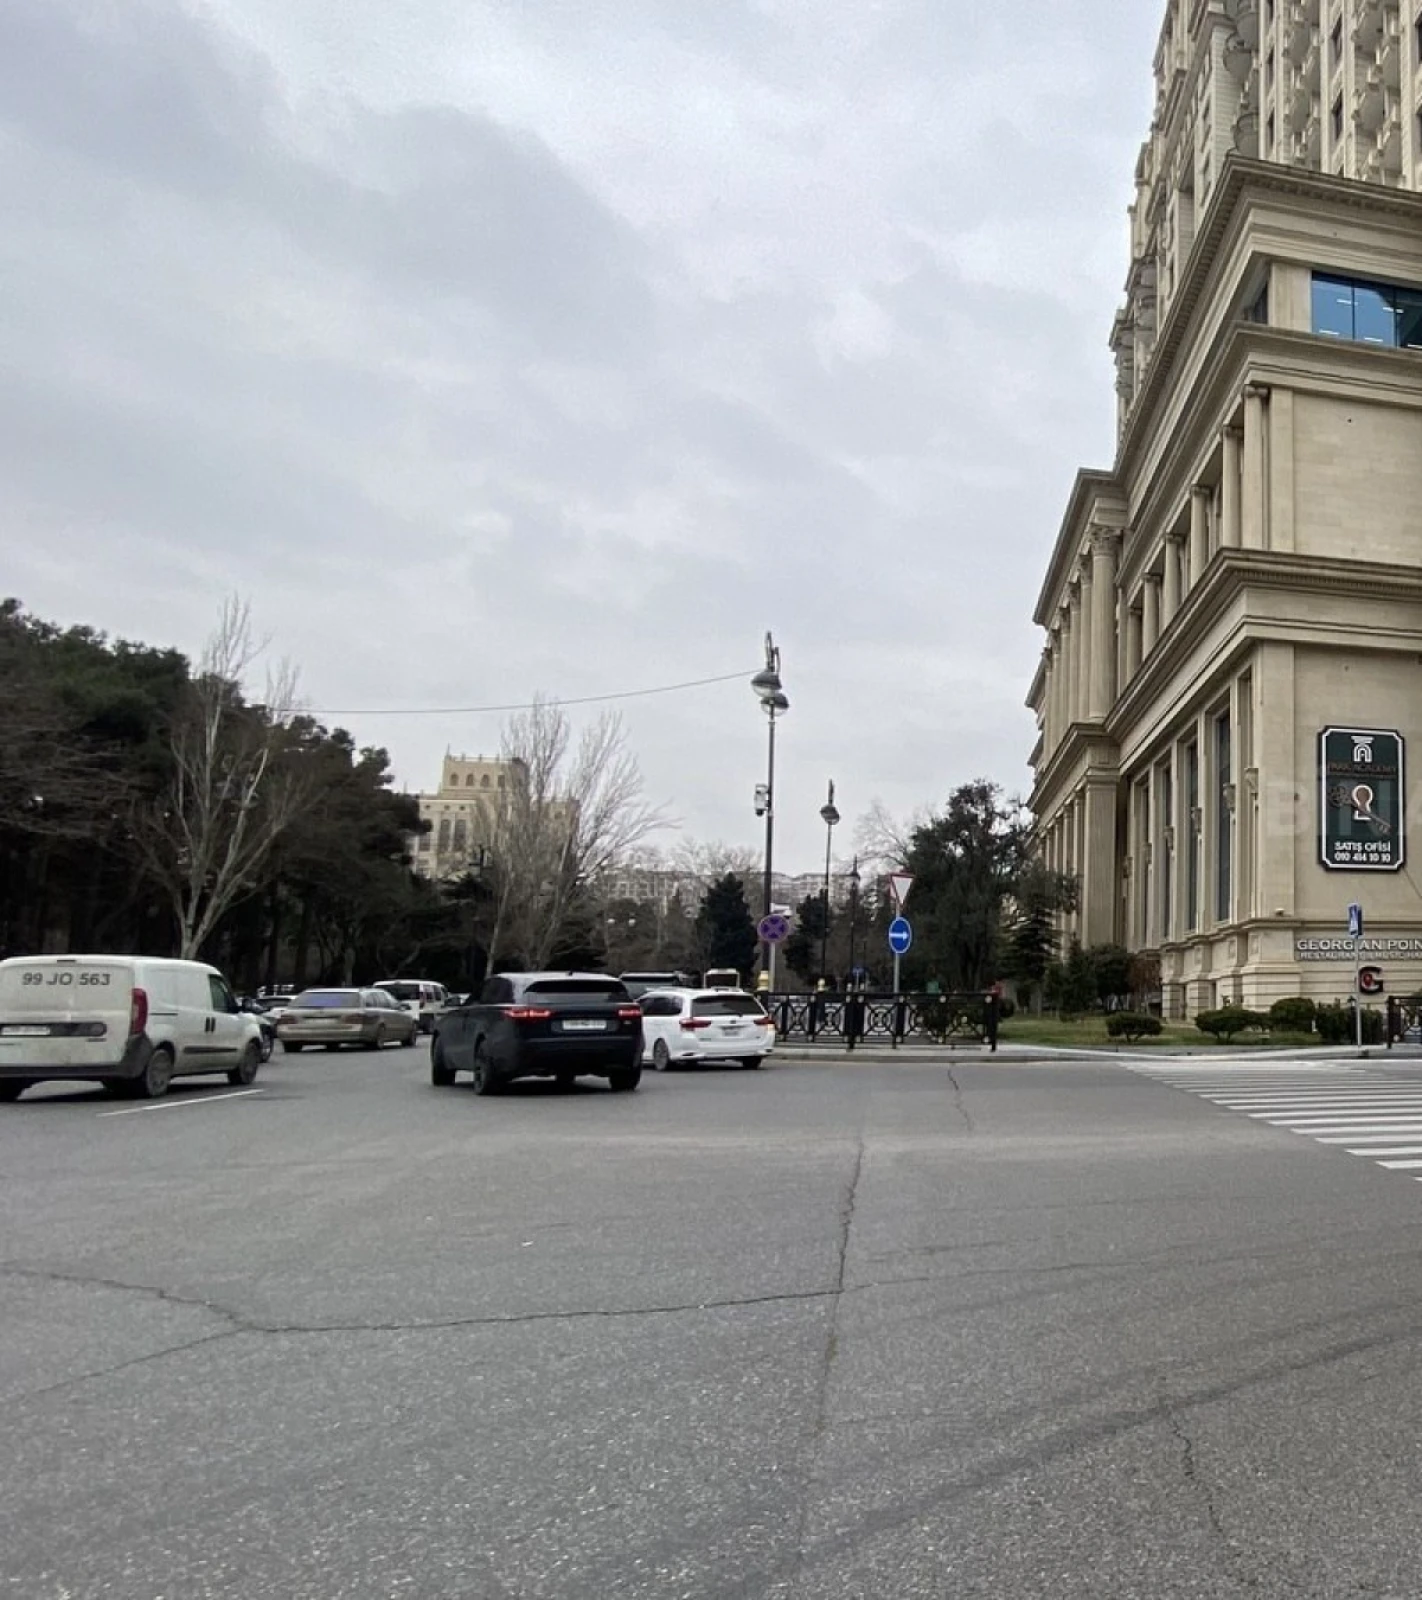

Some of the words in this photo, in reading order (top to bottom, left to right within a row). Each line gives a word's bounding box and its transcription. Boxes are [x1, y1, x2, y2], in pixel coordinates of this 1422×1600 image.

[1334, 852, 1351, 861] 010
[1296, 938, 1383, 950] GEORGAN
[21, 971, 43, 986] 99
[45, 971, 73, 986] JO
[78, 971, 111, 986] 563
